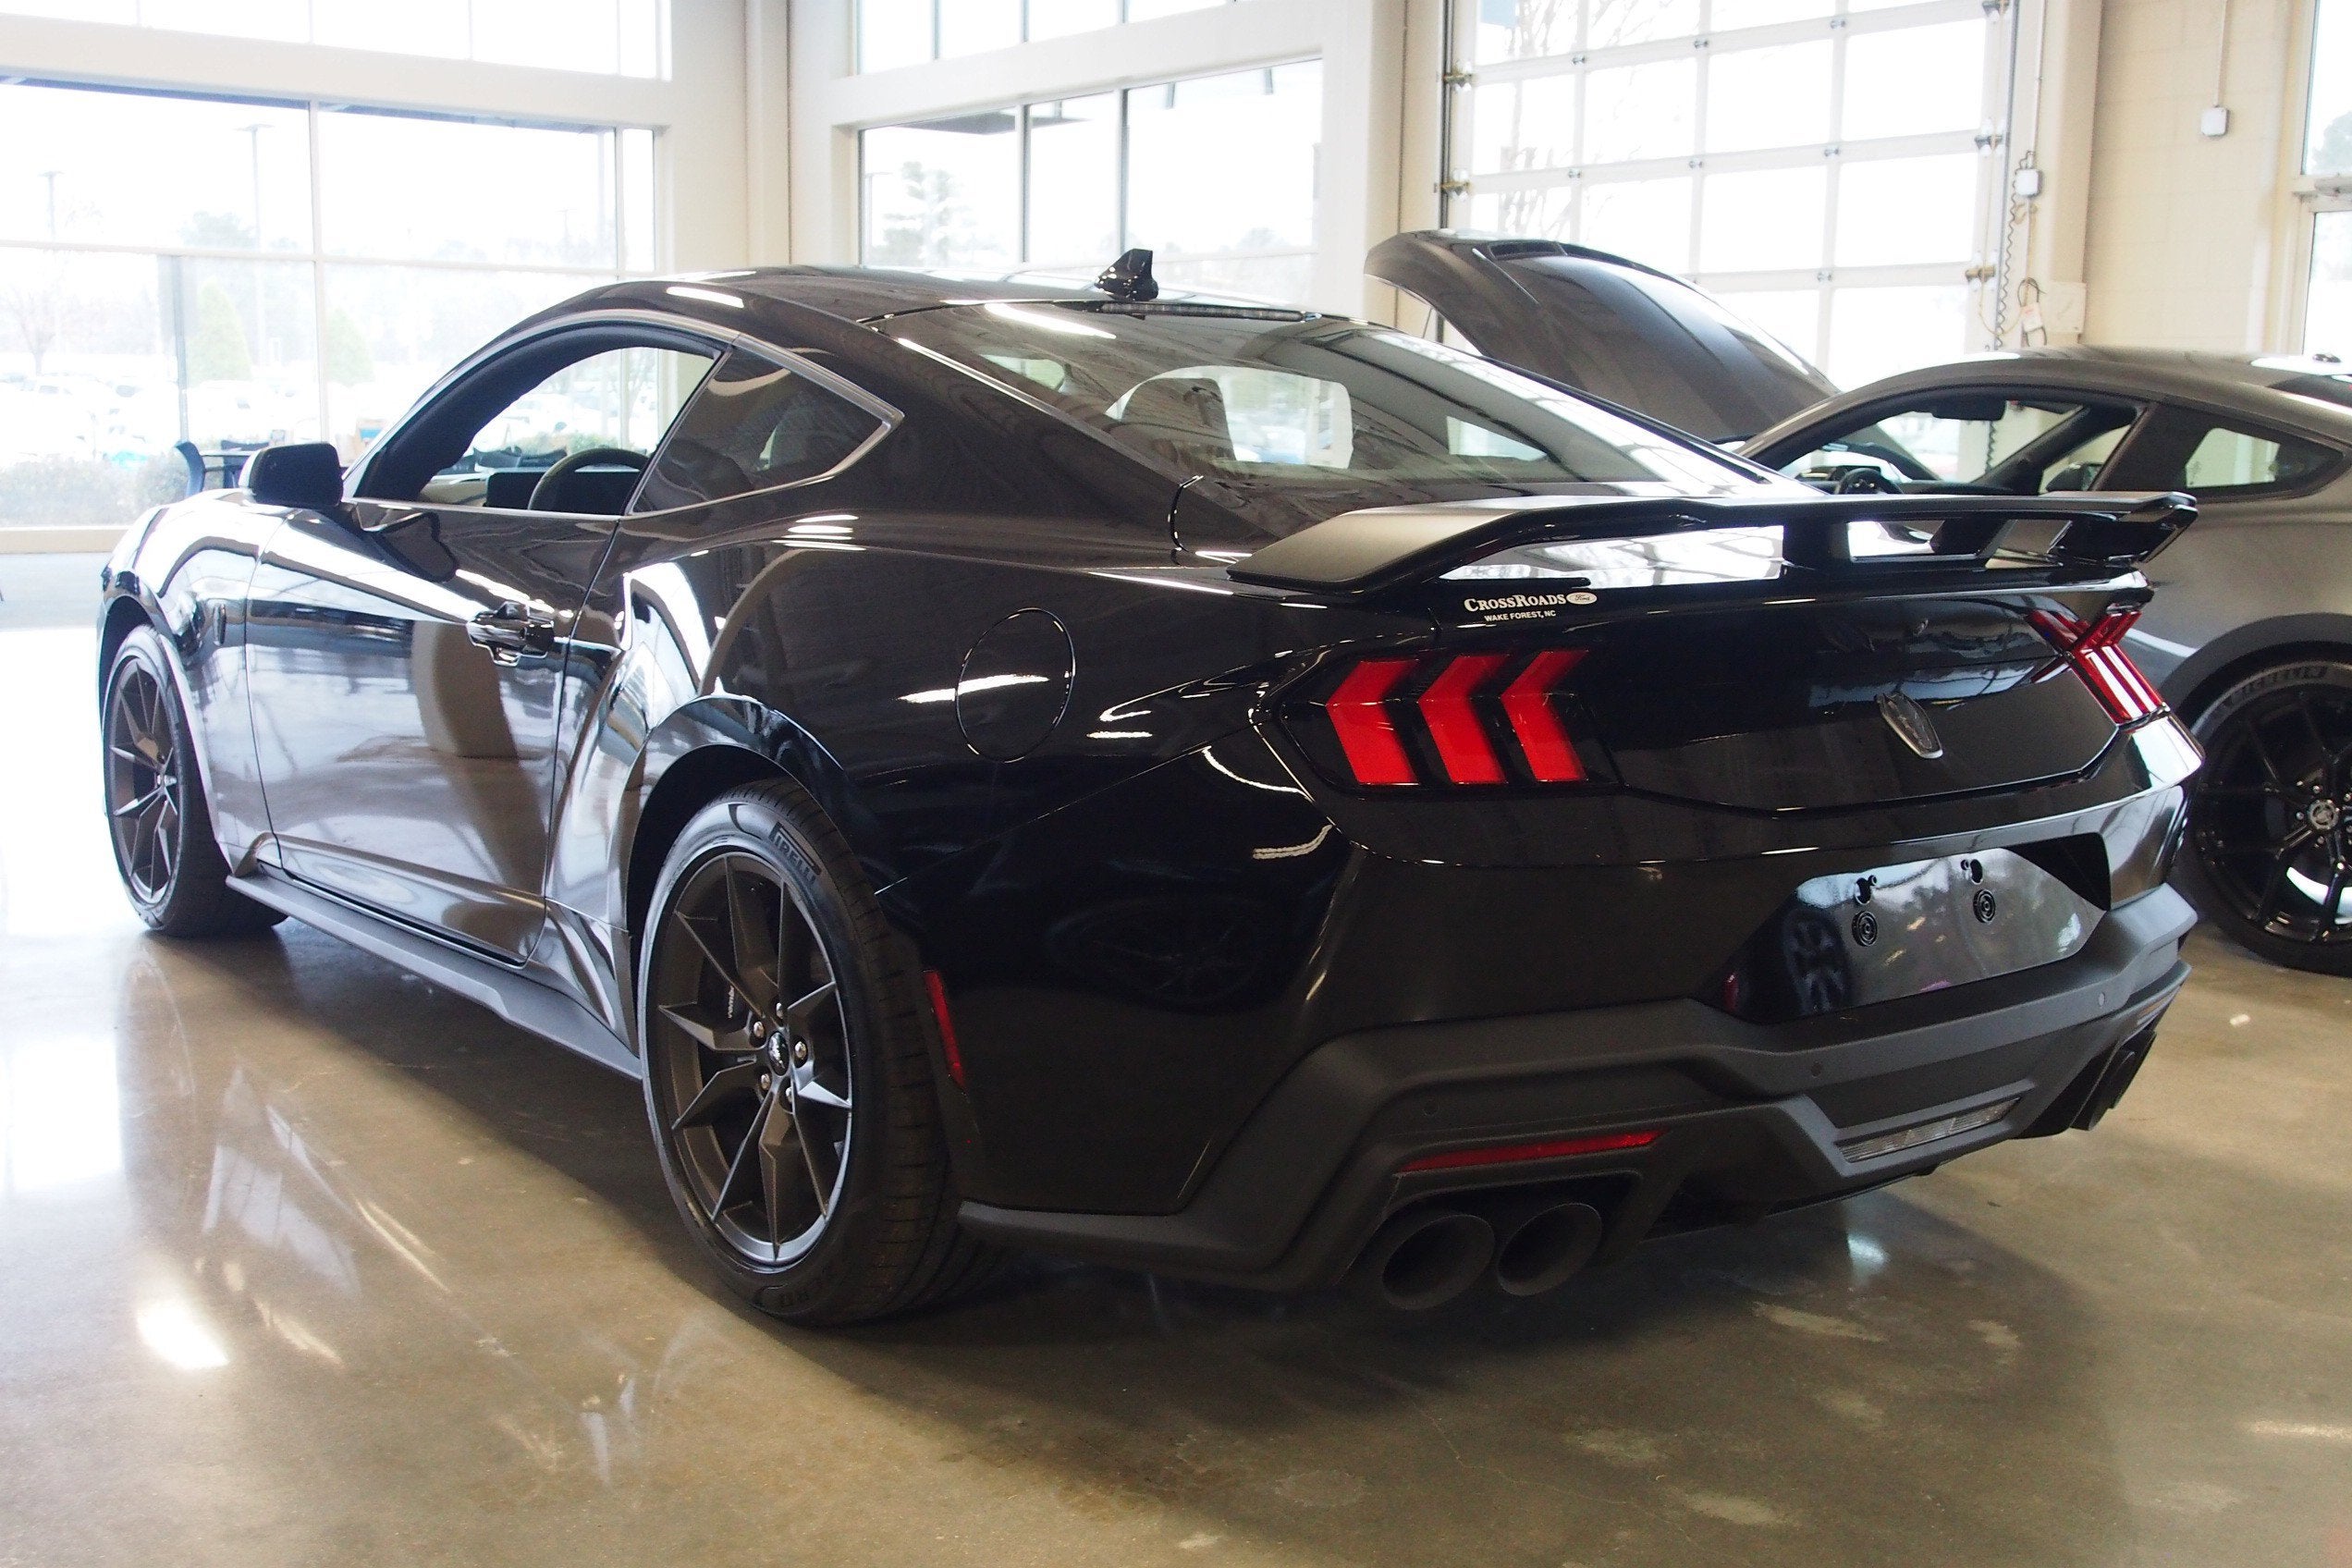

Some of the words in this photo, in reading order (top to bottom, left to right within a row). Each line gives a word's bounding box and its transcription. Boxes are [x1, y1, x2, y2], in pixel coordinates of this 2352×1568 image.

[1464, 594, 1567, 612] CROSSROADS
[1484, 614, 1509, 622] WAKE
[1510, 611, 1544, 620] FOREST,
[768, 821, 821, 885] PIRELLI
